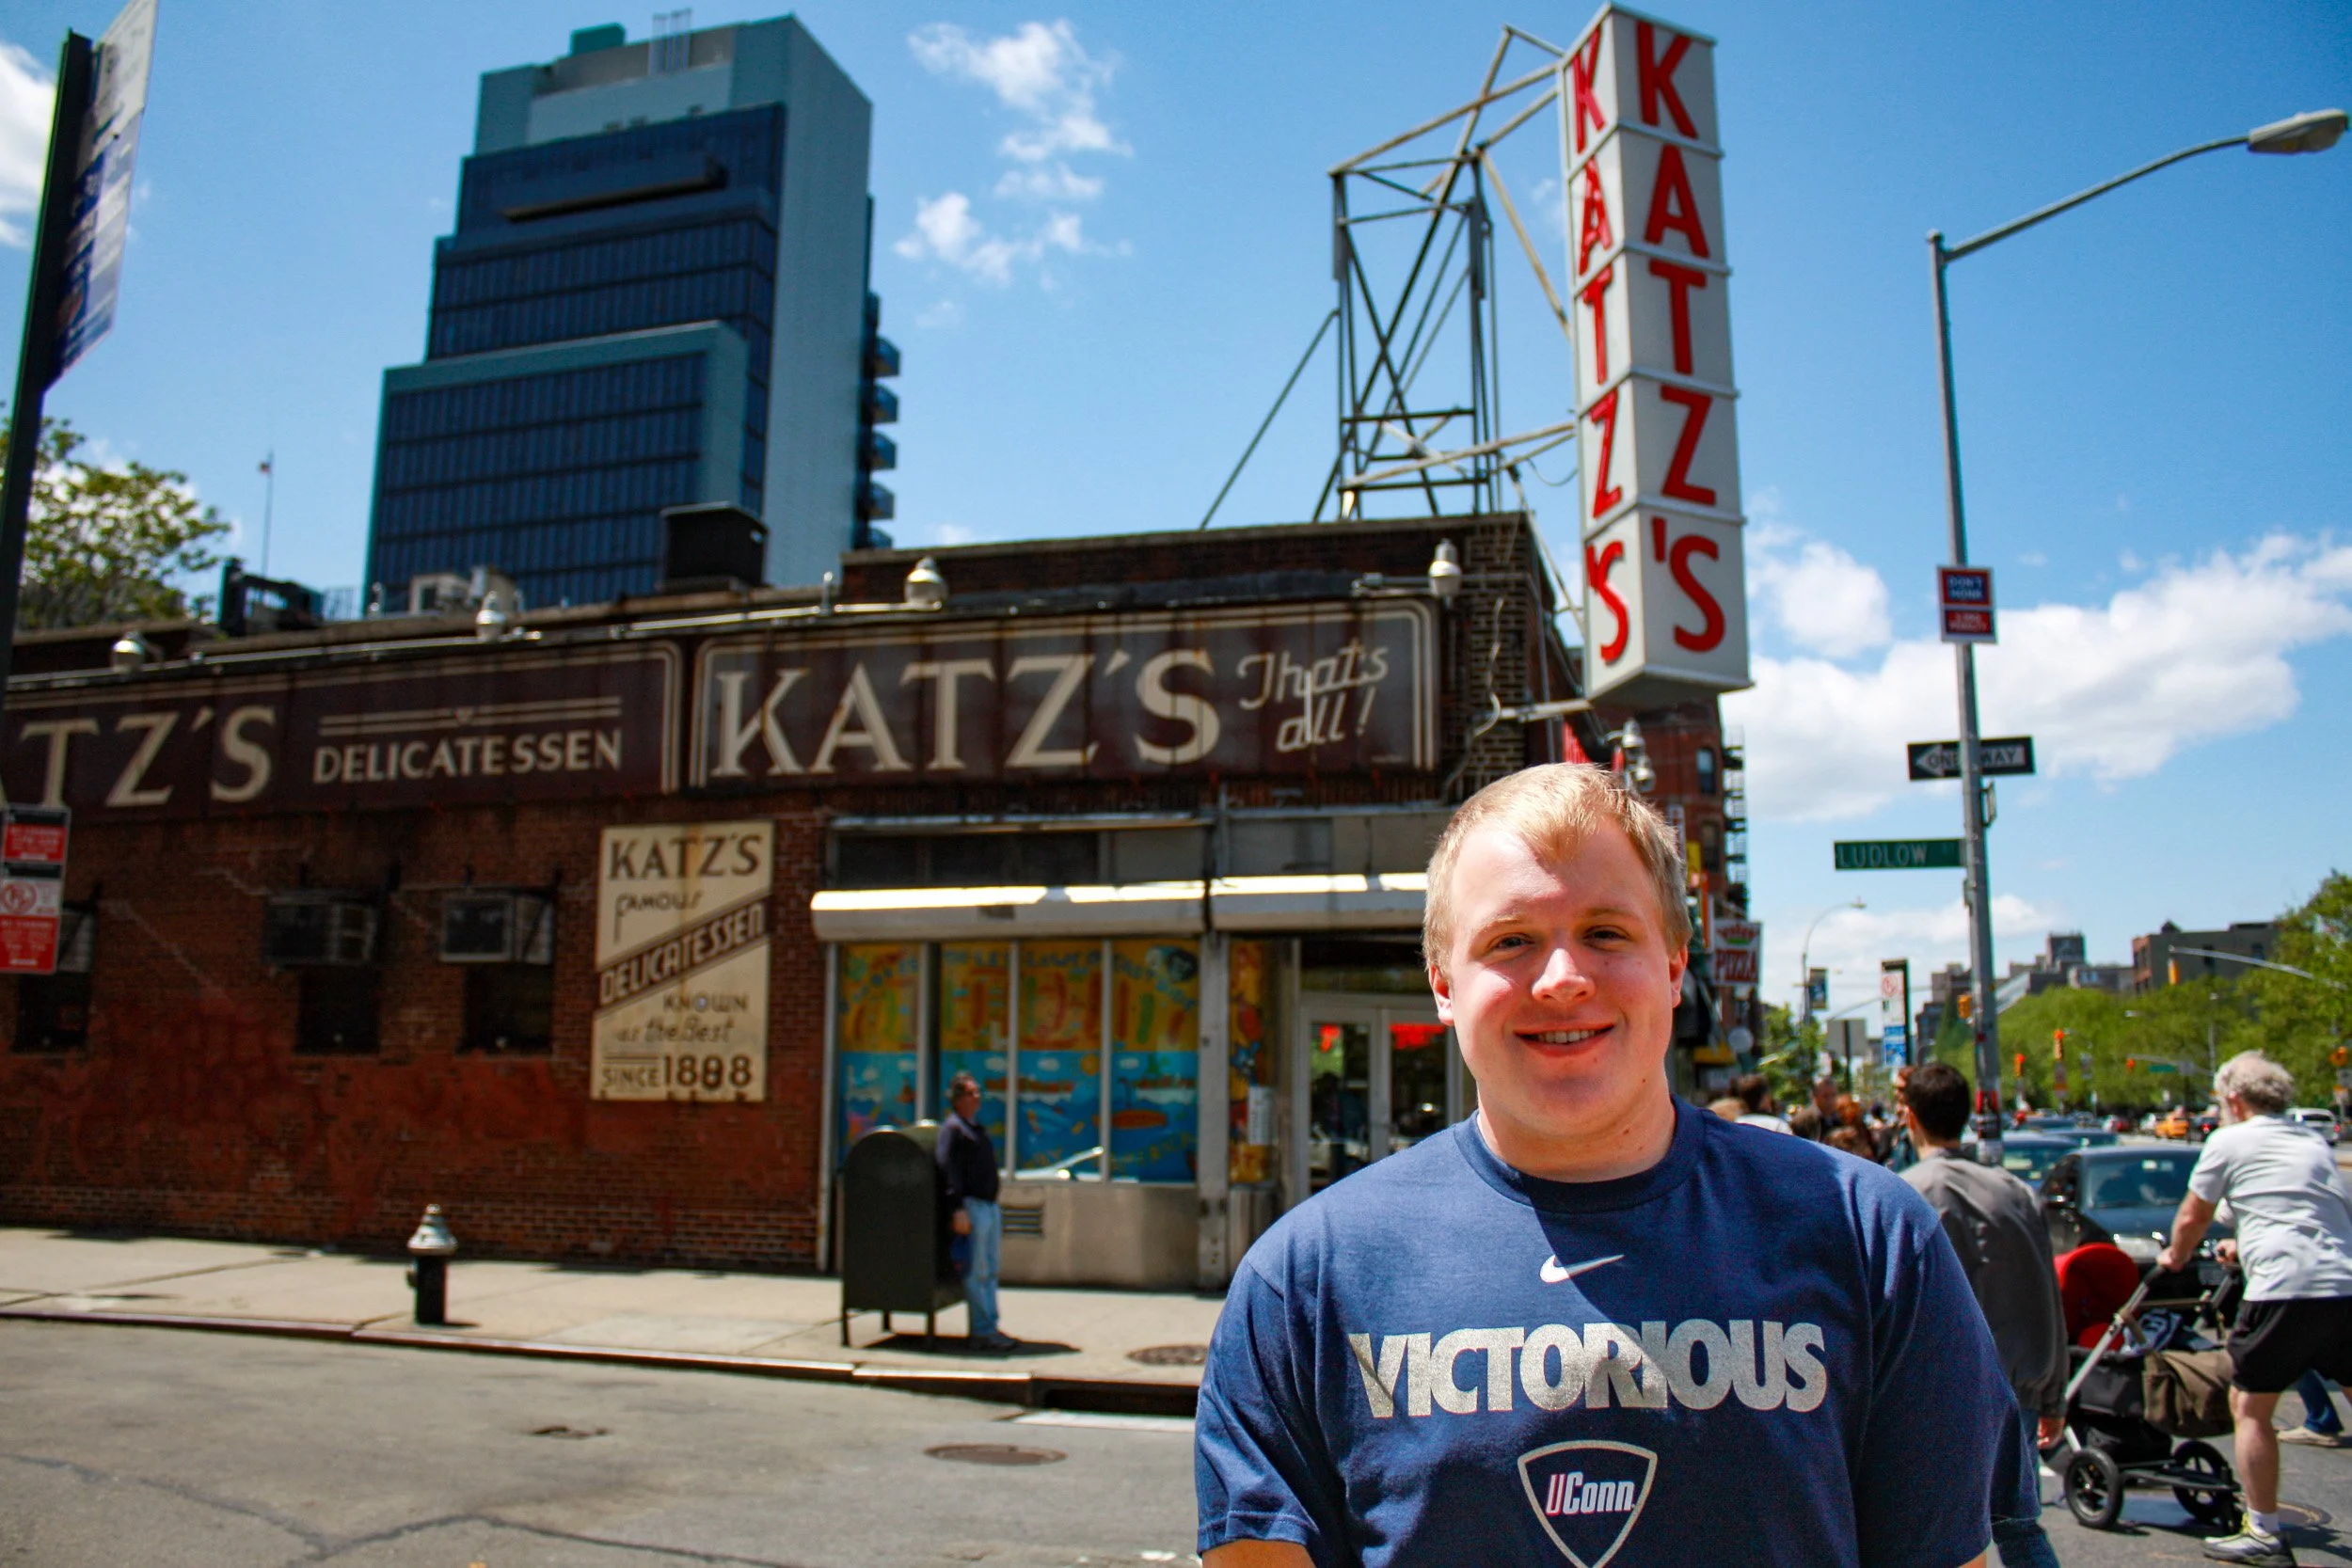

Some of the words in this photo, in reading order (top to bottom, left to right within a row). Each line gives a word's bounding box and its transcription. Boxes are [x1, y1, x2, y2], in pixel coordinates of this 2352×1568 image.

[1571, 28, 1629, 666] KATZ'S
[1636, 21, 1727, 654] KATZ'S
[710, 648, 1221, 777] KATZ'S
[0, 706, 277, 807] TZ'S
[312, 730, 622, 785] DELICATESSEN
[609, 832, 764, 880] KATZ'S
[1837, 843, 1929, 868] LUDLOW
[600, 900, 765, 1006] DELICATESSEN
[1715, 948, 1758, 982] PIZZA
[662, 992, 748, 1014] KNOWN
[601, 1066, 660, 1088] SINCE
[1348, 1319, 1828, 1418] VICTORIOUS
[1545, 1470, 1636, 1516] UConn
